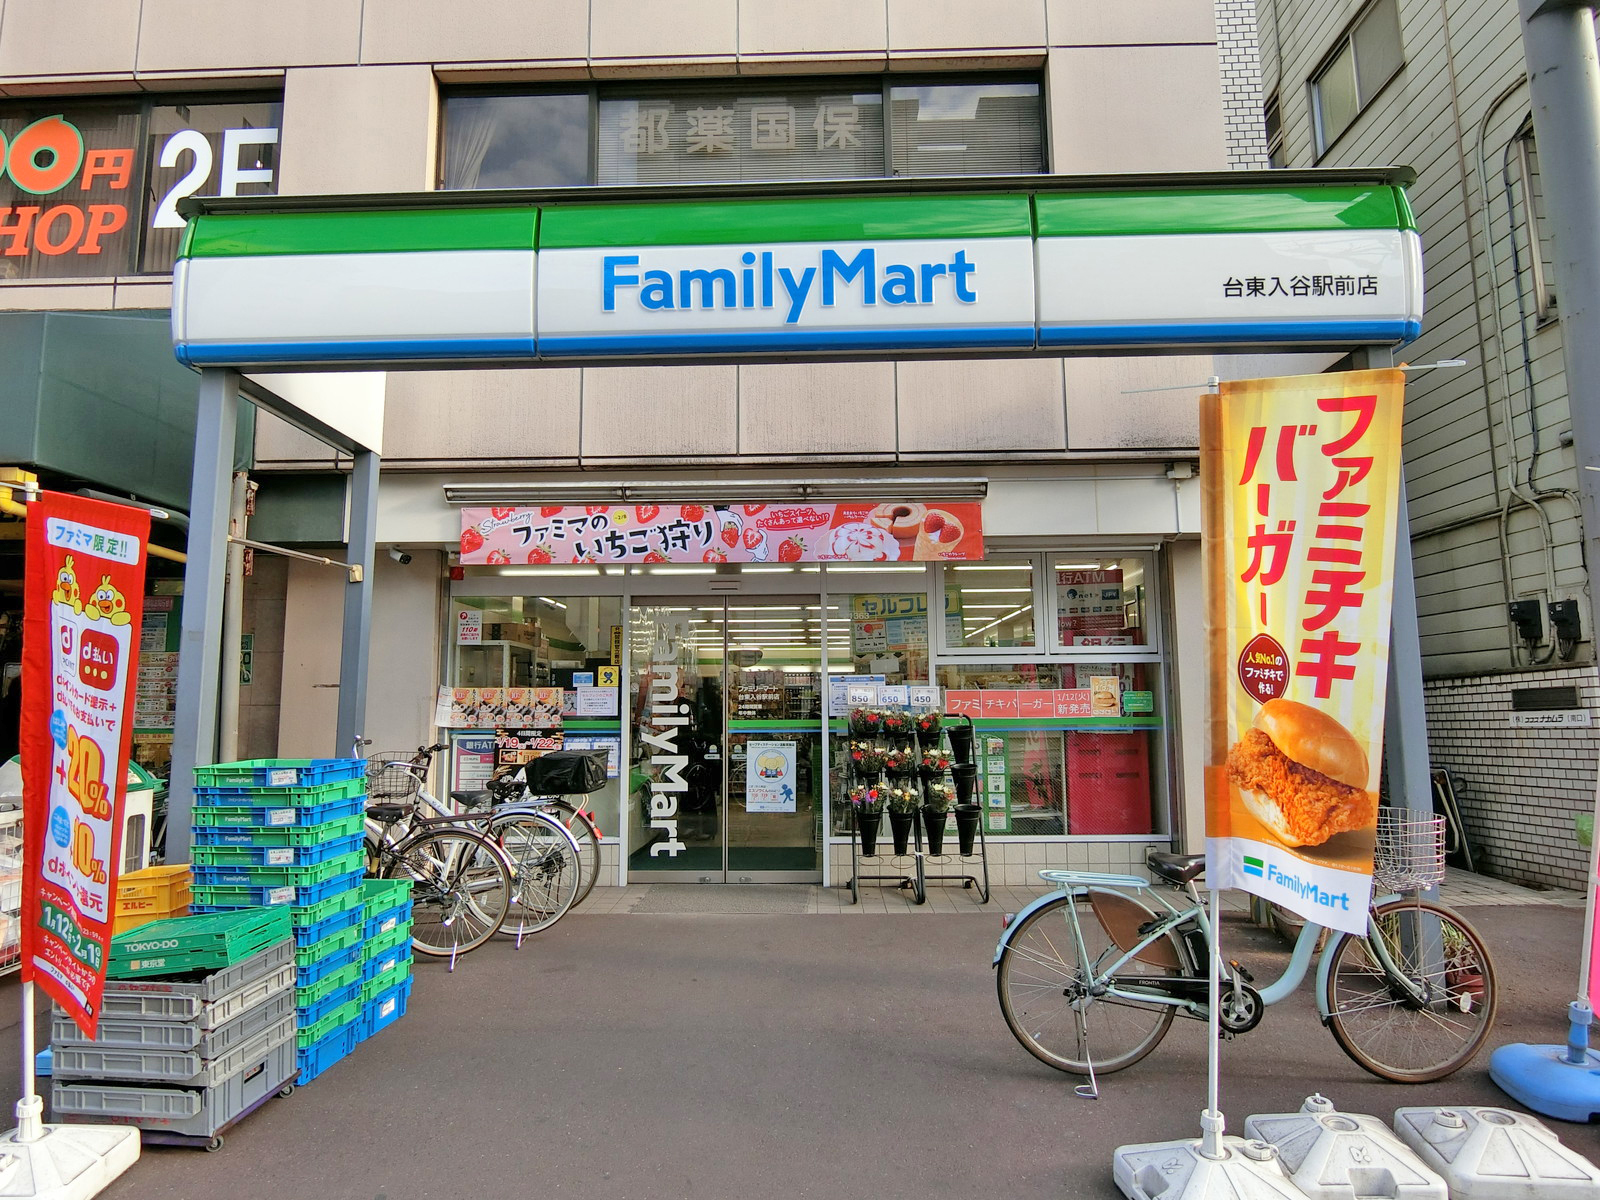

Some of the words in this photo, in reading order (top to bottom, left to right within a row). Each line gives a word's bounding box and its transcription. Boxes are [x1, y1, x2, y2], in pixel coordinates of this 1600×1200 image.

[619, 104, 861, 154] 都薬国保
[0, 114, 134, 195] 0円
[153, 128, 279, 228] 2F
[601, 247, 978, 325] FamilyMart
[1223, 275, 1378, 297] 台東入谷駅前店
[481, 512, 533, 535] Strawberry
[512, 514, 609, 545] ファミマの
[1239, 424, 1318, 627] バーガー
[55, 525, 128, 559] ファミマ限定!!
[575, 518, 714, 559] いちご狩り
[1295, 395, 1378, 698] ファミチキ
[1058, 620, 1077, 628] ow?
[82, 642, 113, 664] d払い
[1246, 652, 1283, 666] 人気No.1の
[1245, 667, 1284, 682] ファミチキで
[851, 695, 868, 703] 850
[1057, 691, 1090, 702] 1/12(火)
[1258, 683, 1274, 695] 作る!
[1057, 703, 1091, 714] 新発売
[466, 741, 495, 750] 銀行AT
[640, 615, 690, 857] FamilyMart
[226, 775, 253, 783] FamilyMart
[1267, 863, 1350, 912] FamilyMart
[123, 901, 153, 910] エルビー
[124, 939, 179, 952] TOKYO-DO
[141, 958, 165, 969] 東京堂
